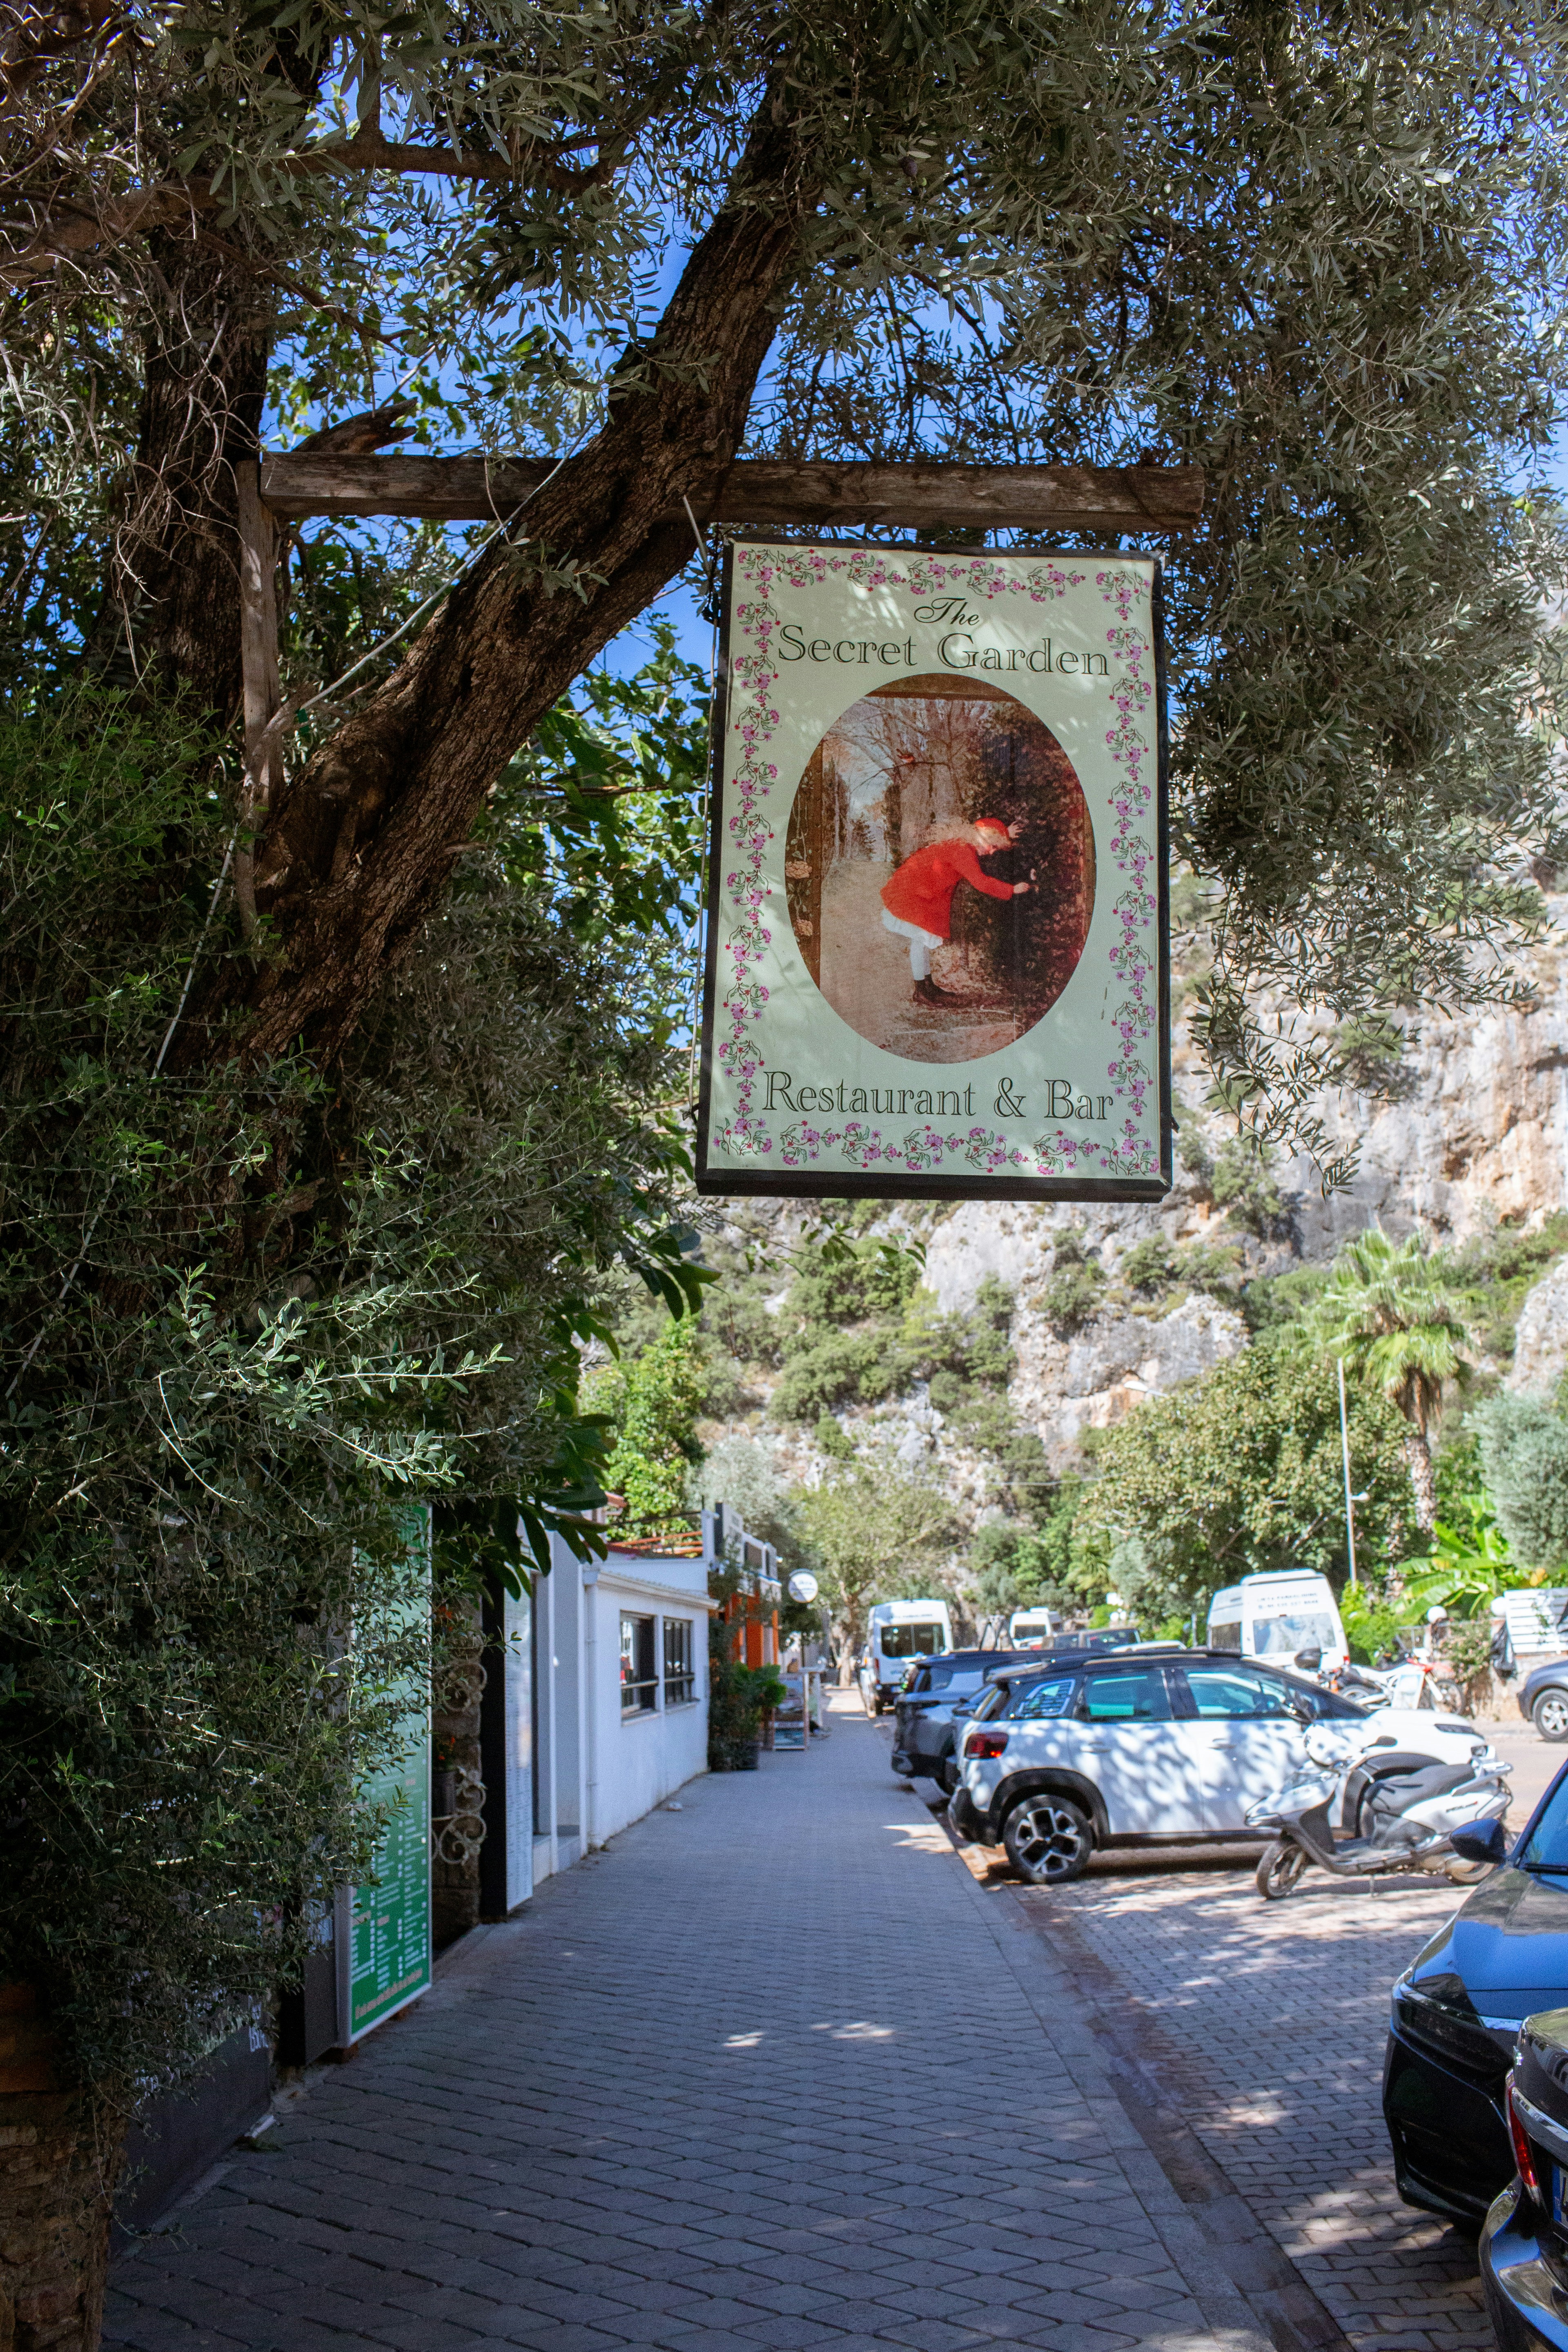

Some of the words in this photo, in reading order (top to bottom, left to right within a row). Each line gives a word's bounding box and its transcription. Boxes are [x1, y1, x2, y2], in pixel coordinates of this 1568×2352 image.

[913, 597, 980, 626] The
[778, 624, 918, 666] Secret
[937, 633, 1110, 675] Garden
[762, 1071, 976, 1116] Restaurant
[993, 1077, 1027, 1117] &
[1044, 1079, 1113, 1120] Bar
